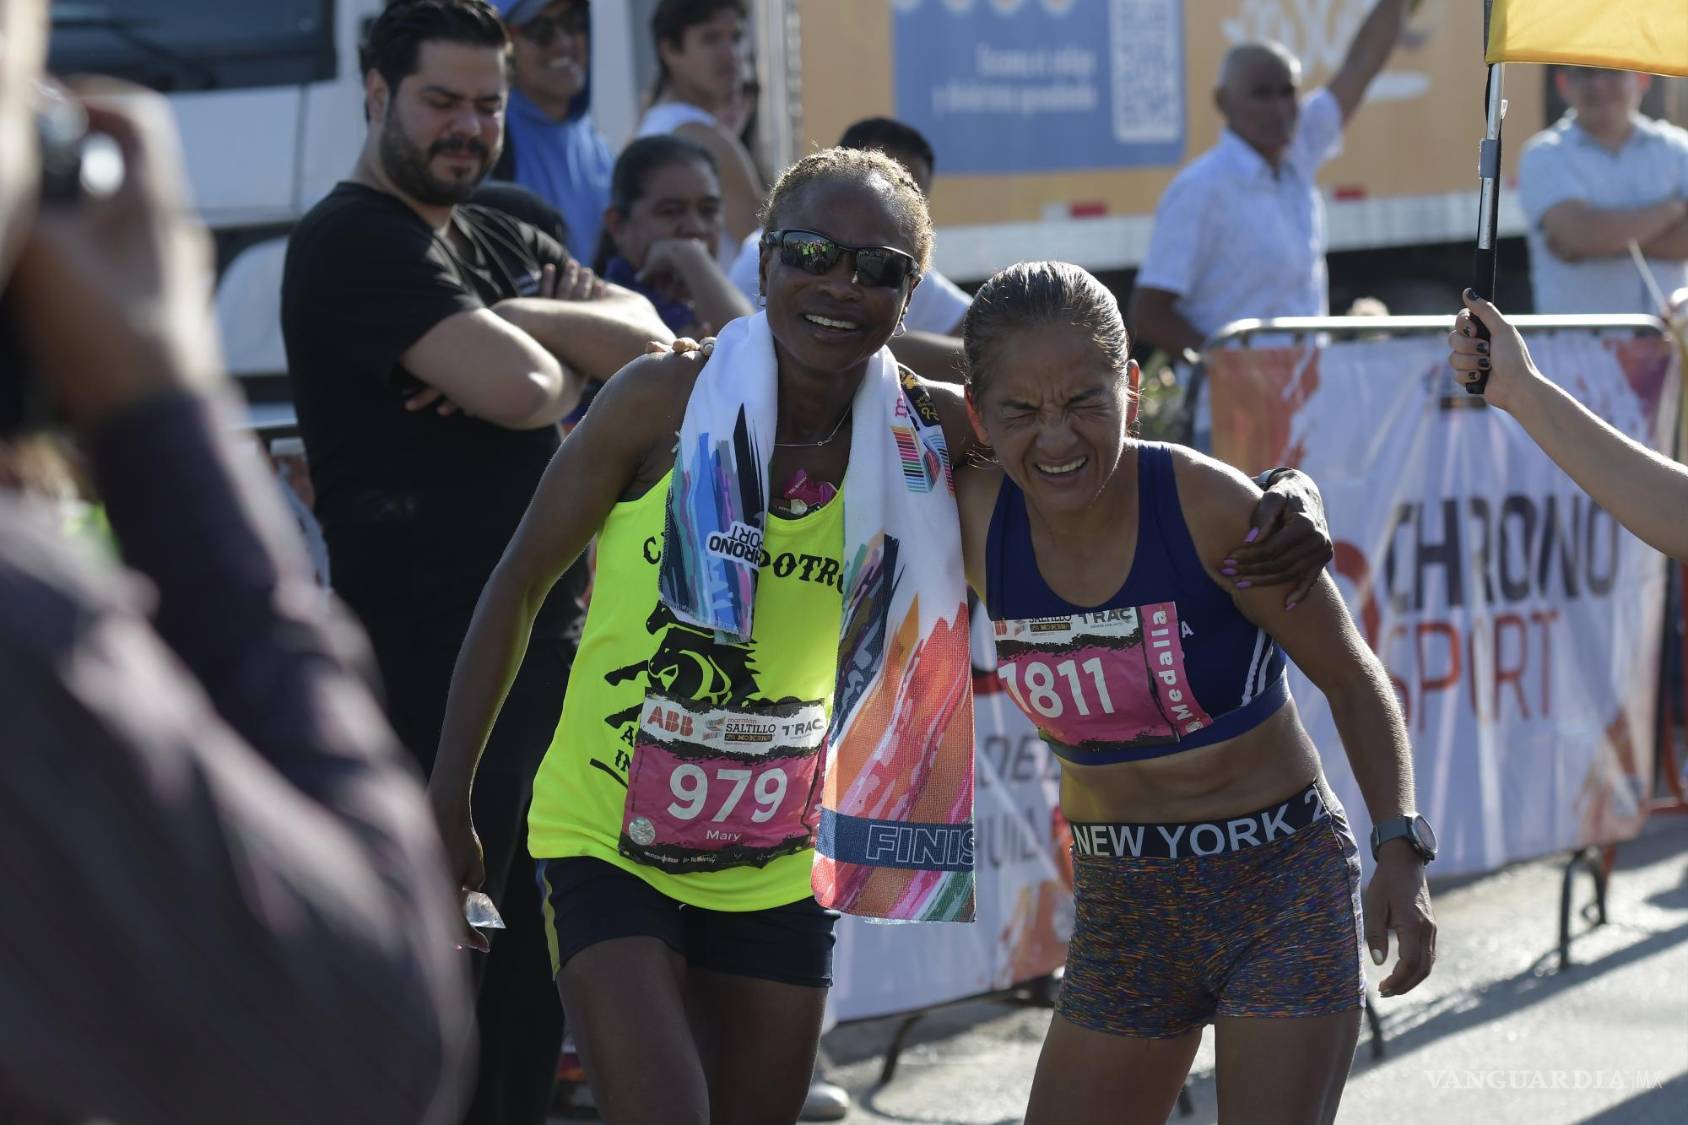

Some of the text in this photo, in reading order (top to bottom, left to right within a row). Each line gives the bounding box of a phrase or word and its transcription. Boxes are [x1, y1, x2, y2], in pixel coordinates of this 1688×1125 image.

[727, 524, 764, 550] ORT
[1385, 494, 1620, 610] CHRONO
[998, 657, 1115, 719] 1811
[647, 706, 694, 737] ABB
[726, 723, 776, 734] SALTILLO
[782, 718, 824, 736] TRAC
[666, 763, 788, 824] 979
[706, 830, 741, 843] Mary
[1074, 825, 1145, 857] NEW
[1156, 804, 1297, 858] YORK
